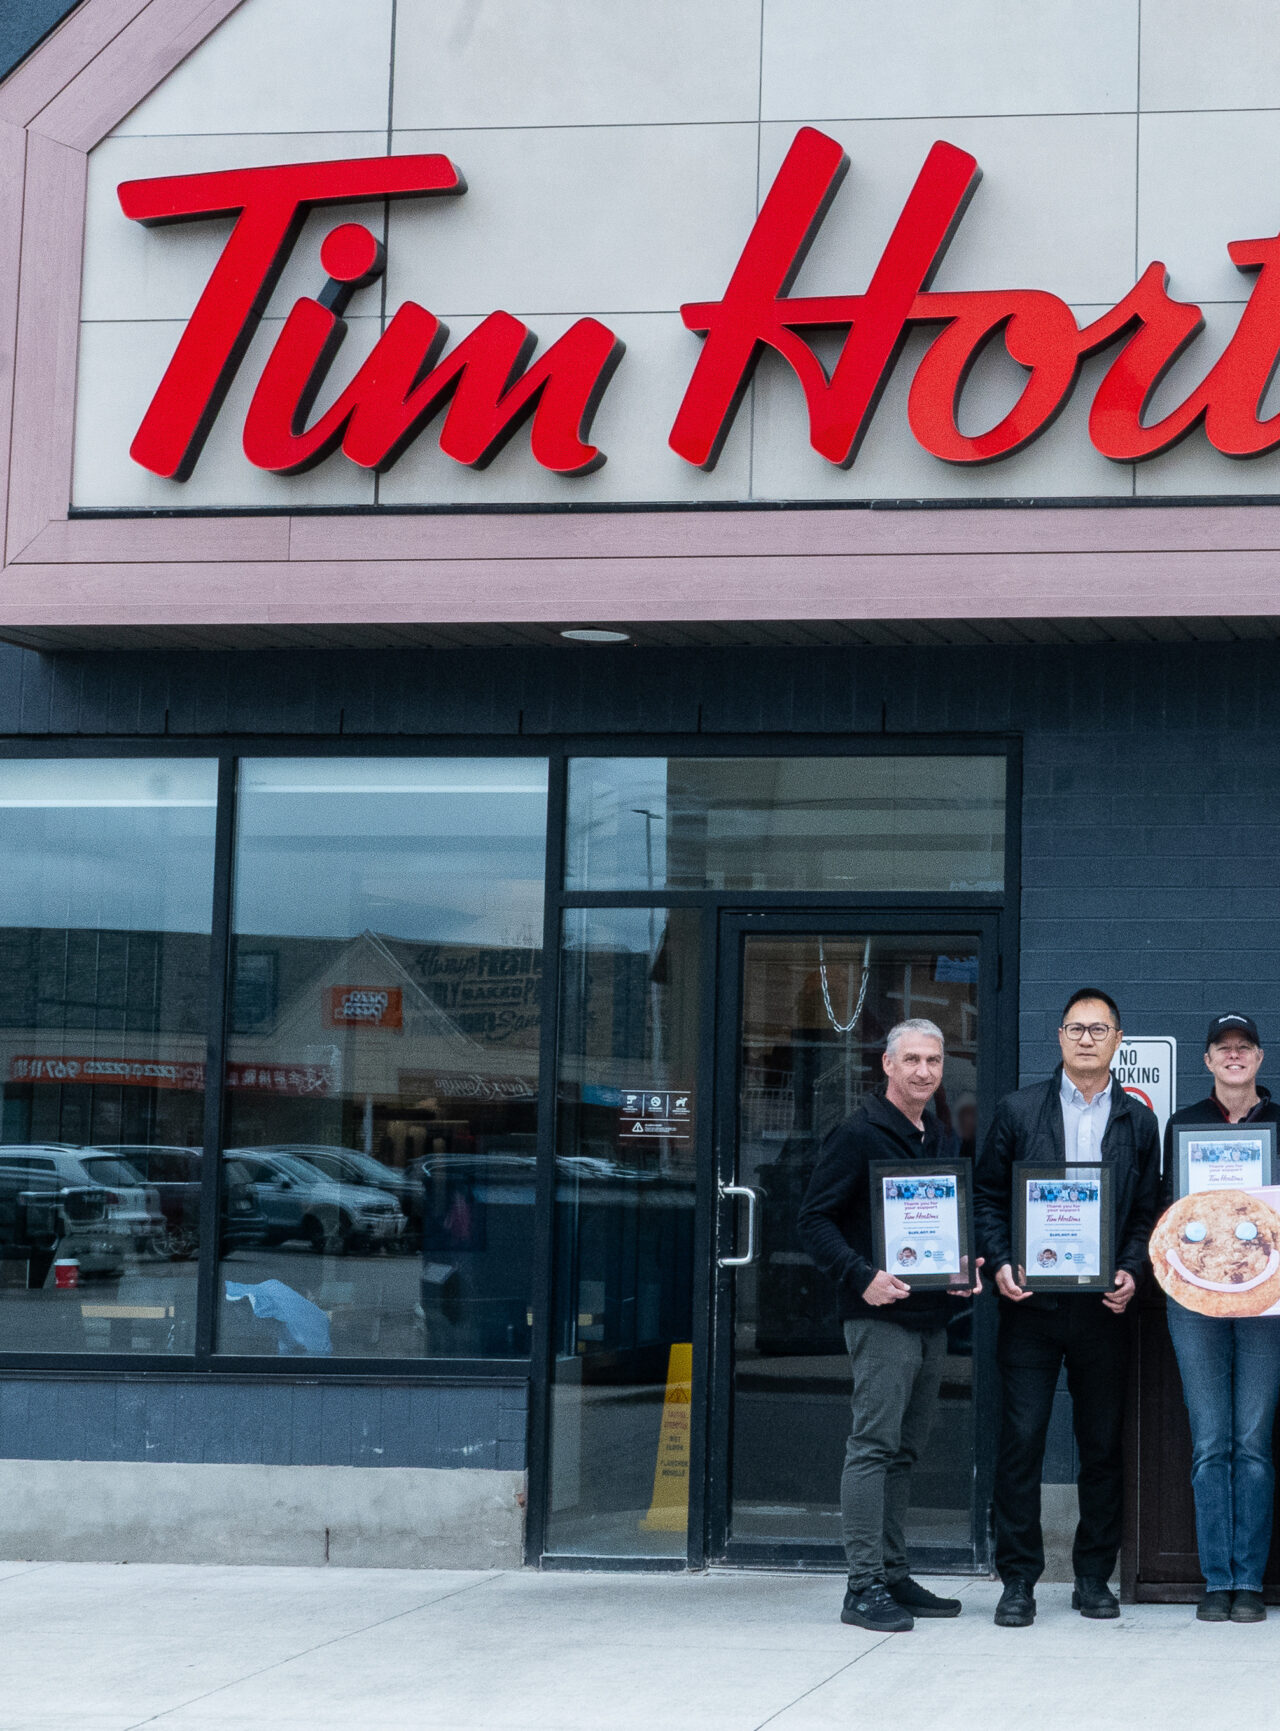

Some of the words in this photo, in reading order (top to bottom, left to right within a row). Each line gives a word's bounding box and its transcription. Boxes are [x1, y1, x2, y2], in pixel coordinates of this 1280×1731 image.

[118, 154, 626, 482] Tim
[1119, 1049, 1137, 1066] NO
[1112, 1067, 1160, 1084] OKING
[904, 1212, 915, 1221] Tim
[915, 1211, 939, 1220] Hortons
[1046, 1215, 1057, 1223] Tim
[1057, 1214, 1081, 1223] Hortons
